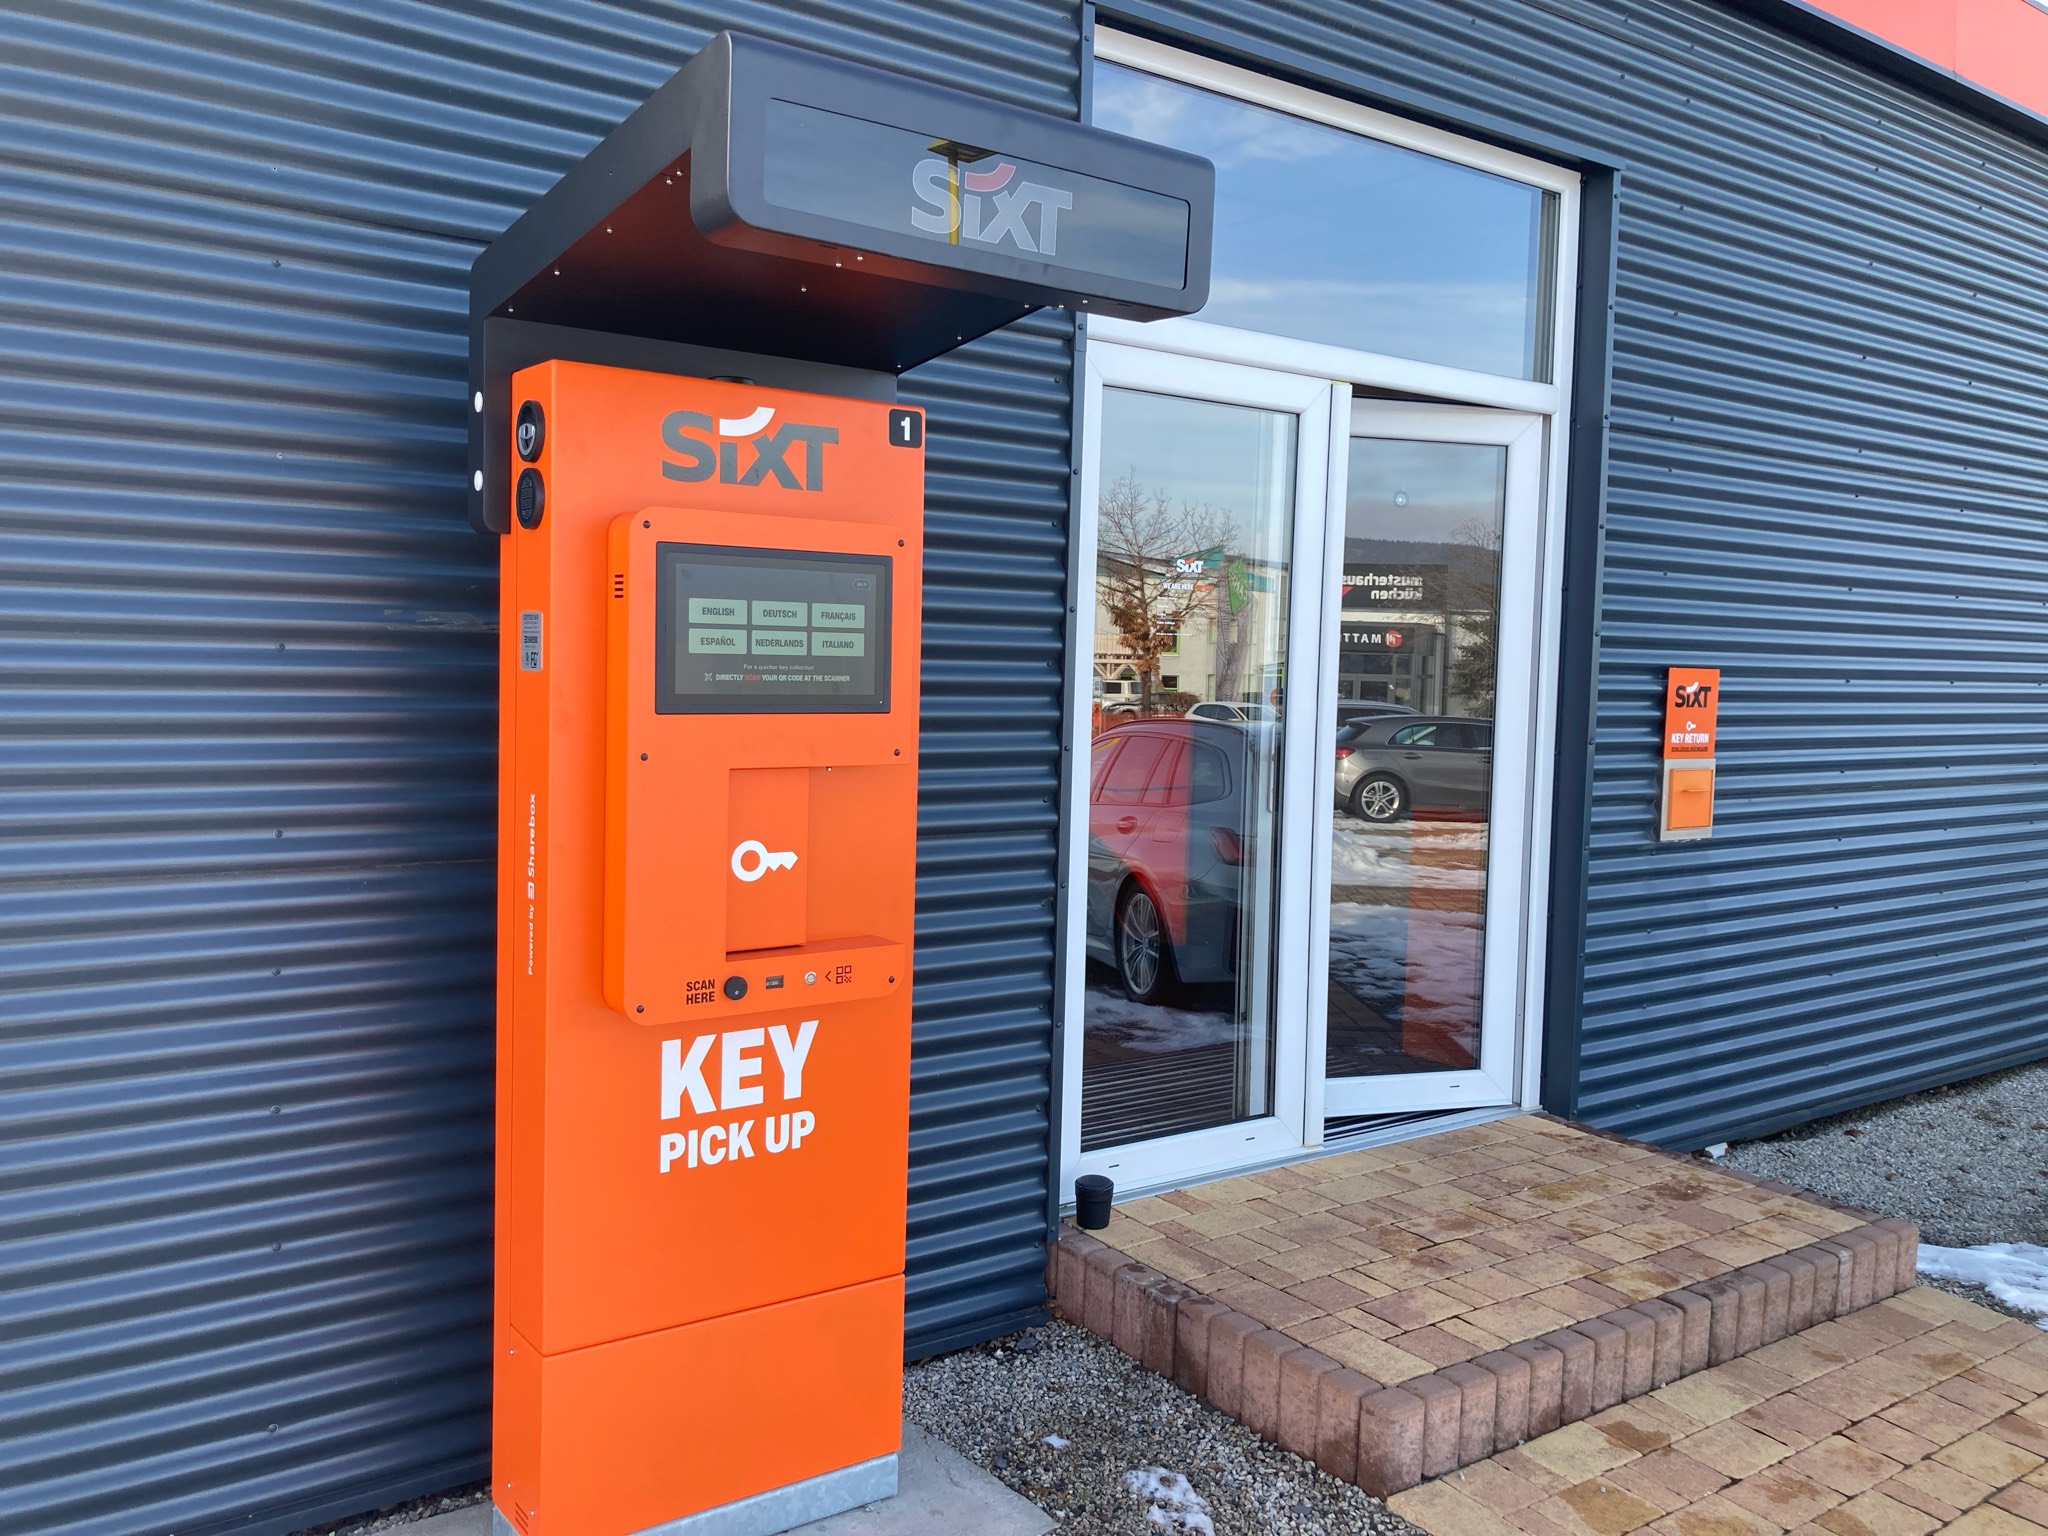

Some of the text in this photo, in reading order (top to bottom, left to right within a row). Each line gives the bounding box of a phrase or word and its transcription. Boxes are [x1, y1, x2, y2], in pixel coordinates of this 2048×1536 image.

[900, 417, 912, 441] 1
[702, 607, 735, 617] ENGLISH
[763, 609, 797, 619] DEUTSCH
[821, 611, 856, 622] FRANÇAIS
[701, 635, 736, 647] ESPAÑOL
[756, 638, 804, 648] NEDERLANDS
[822, 640, 854, 649] ITALIANO
[758, 664, 778, 672] quicker
[779, 664, 789, 672] key
[715, 673, 744, 681] DIRECTLY
[762, 673, 778, 681] YOUR
[779, 673, 787, 682] QR
[788, 673, 804, 681] CODE
[824, 674, 850, 682] SCANNER
[1671, 733, 1709, 743] KEY RETURN
[528, 793, 537, 878] Sharebox
[529, 904, 535, 919] by
[686, 979, 715, 992] SCAN
[686, 991, 715, 1005] HERE
[661, 1020, 819, 1120] KEY
[660, 1111, 815, 1173] PICK UP
